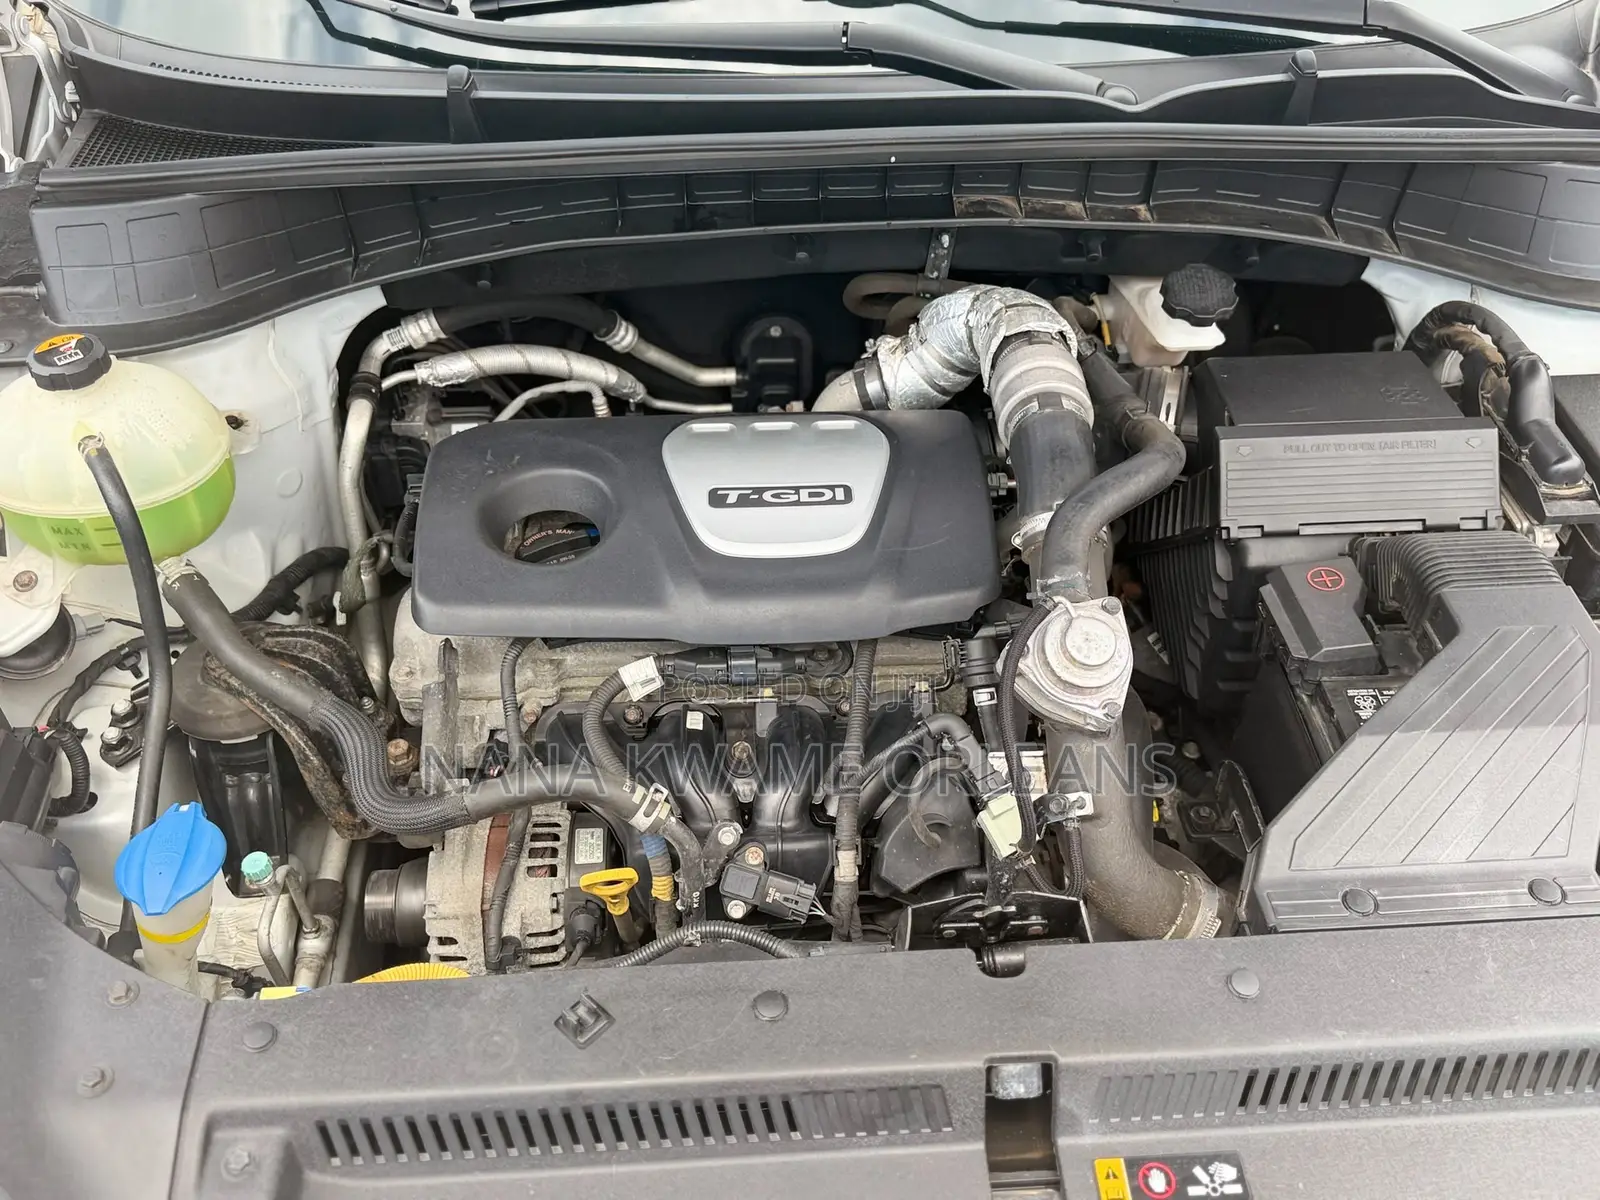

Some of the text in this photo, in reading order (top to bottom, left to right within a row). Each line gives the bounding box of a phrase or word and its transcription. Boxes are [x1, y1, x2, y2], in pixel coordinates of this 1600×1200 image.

[1283, 443, 1309, 454] PULL
[1310, 443, 1330, 453] OUT
[1331, 442, 1346, 452] TO
[1348, 441, 1375, 451] OPEN
[717, 487, 845, 504] T-GDI
[50, 526, 84, 536] MAX
[523, 529, 553, 546] OWNER'S
[58, 541, 91, 550] MIN
